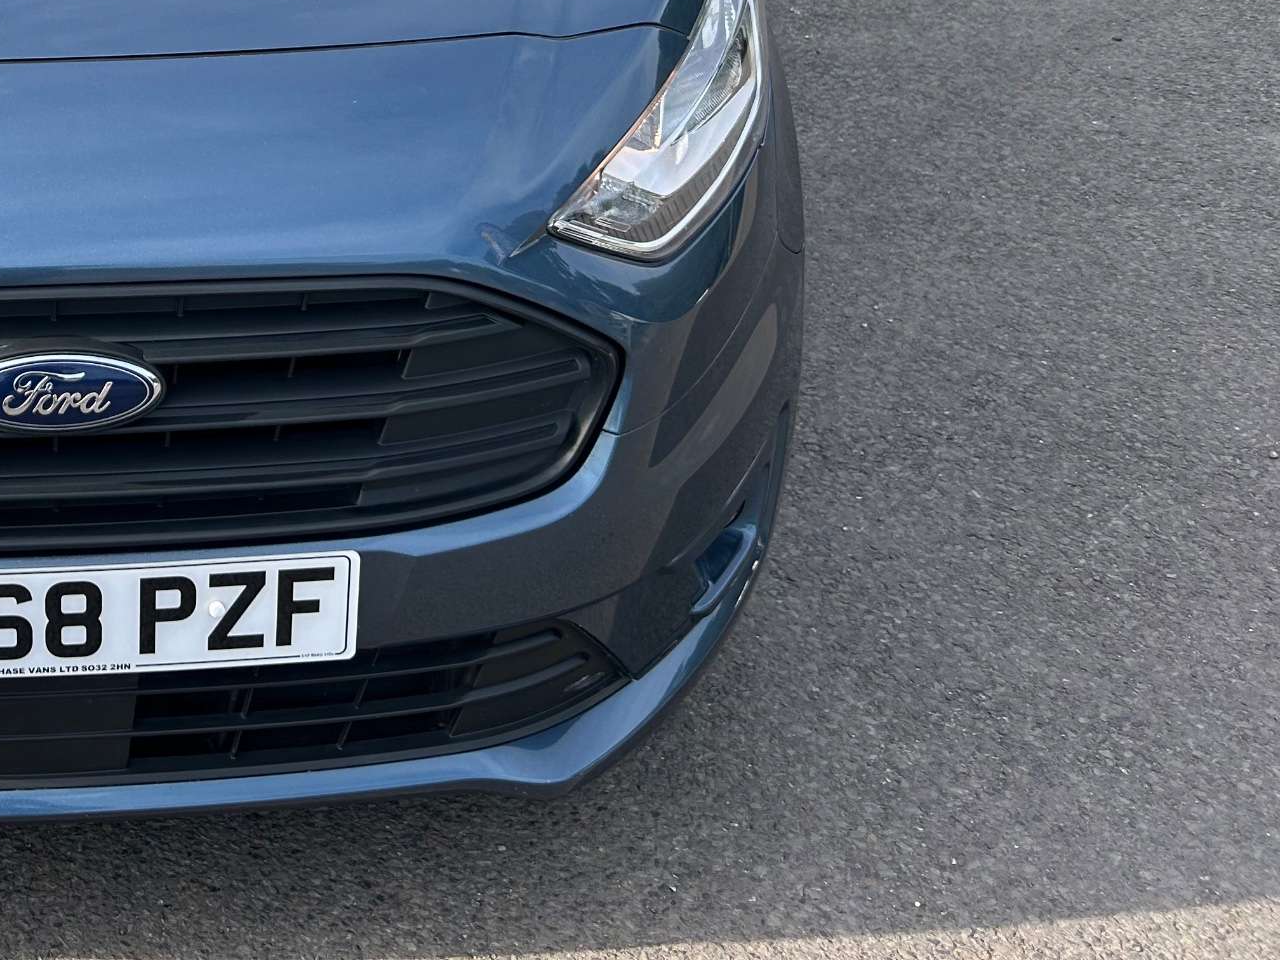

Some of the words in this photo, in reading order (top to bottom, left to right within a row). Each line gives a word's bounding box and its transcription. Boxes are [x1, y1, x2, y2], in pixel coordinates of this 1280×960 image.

[2, 371, 113, 416] Ford
[139, 566, 335, 655] PZF
[28, 666, 56, 674] VANS
[59, 665, 79, 673] LTD
[81, 664, 107, 672] SO32
